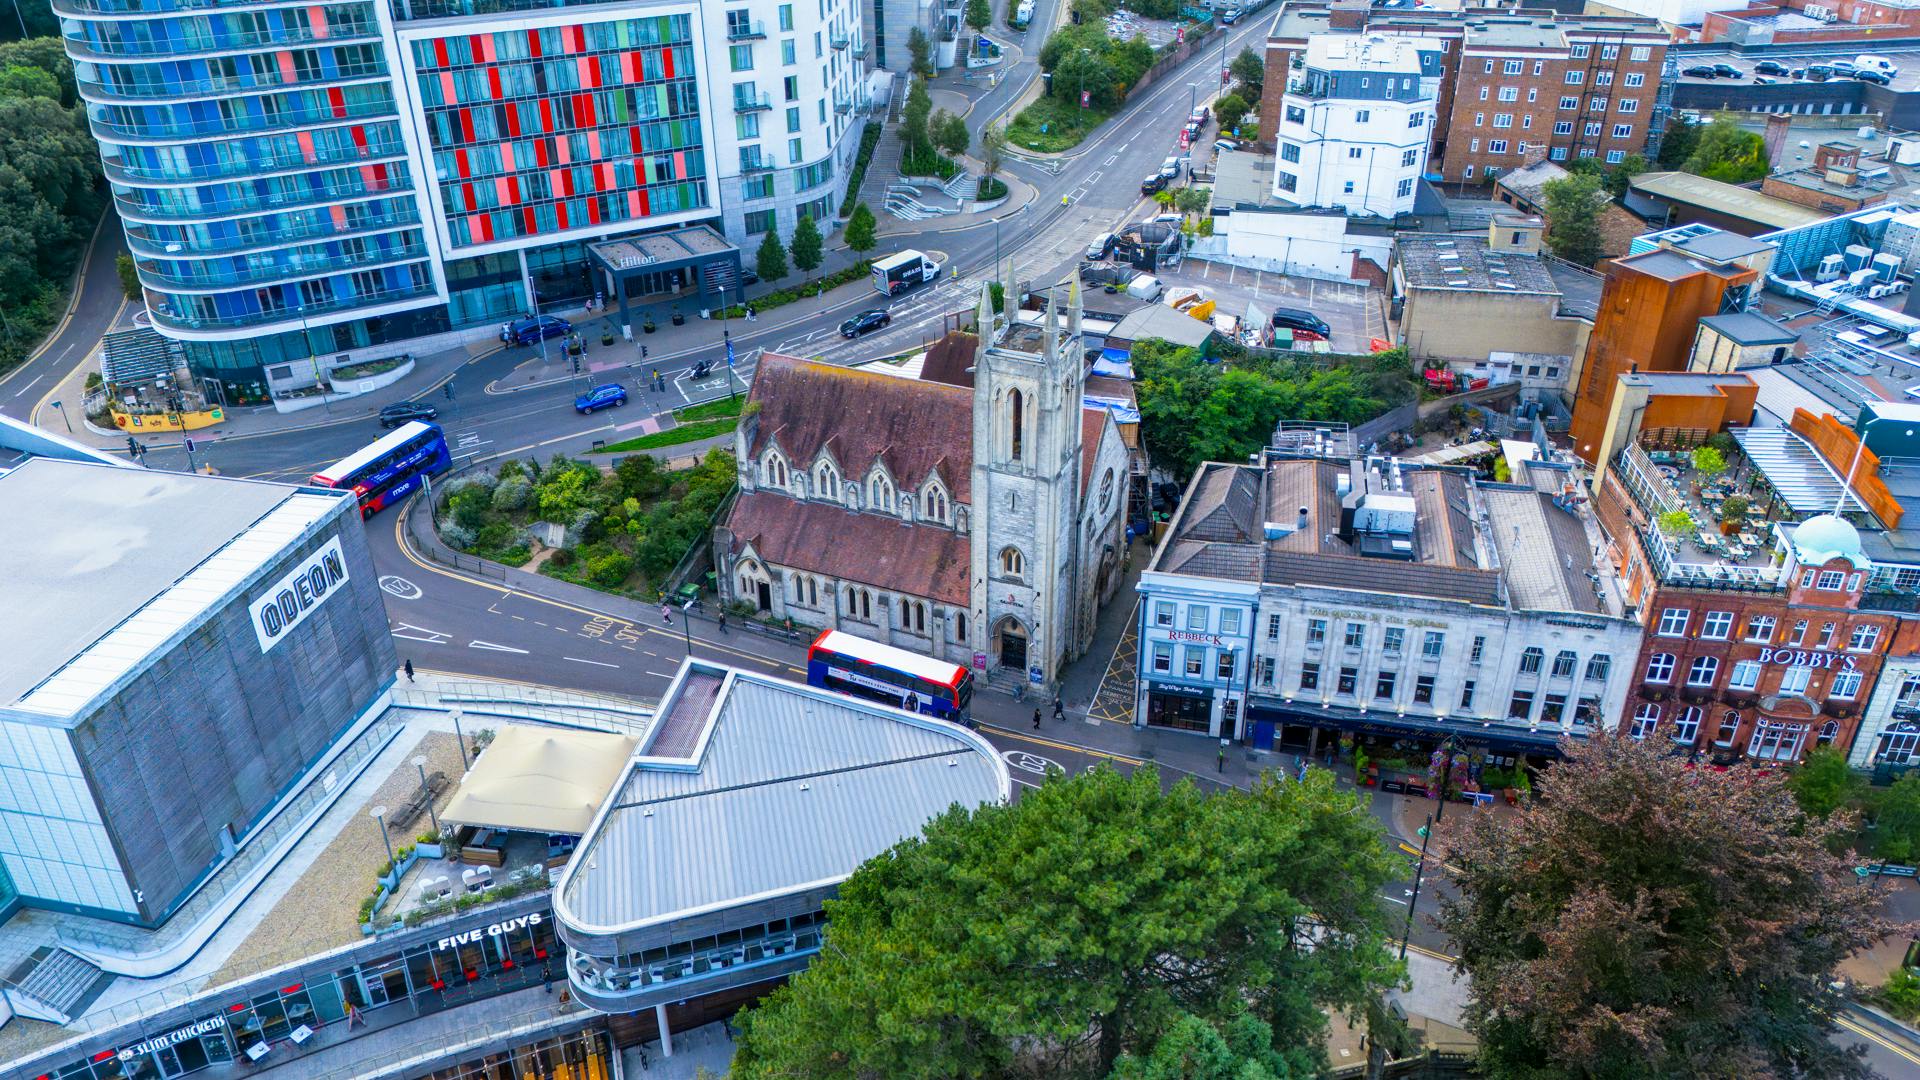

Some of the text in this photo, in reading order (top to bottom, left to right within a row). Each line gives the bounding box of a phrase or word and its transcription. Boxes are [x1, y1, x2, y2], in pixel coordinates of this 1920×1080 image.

[620, 255, 656, 268] Hilton
[392, 481, 410, 497] more
[260, 548, 344, 638] ODEON
[385, 579, 411, 594] 20
[1169, 630, 1222, 646] REBBECK
[1758, 647, 1857, 670] BOBBY'S
[1020, 754, 1047, 772] 20
[438, 913, 542, 951] FIVE GUYS
[137, 1015, 225, 1055] SLIM CHICKENS
